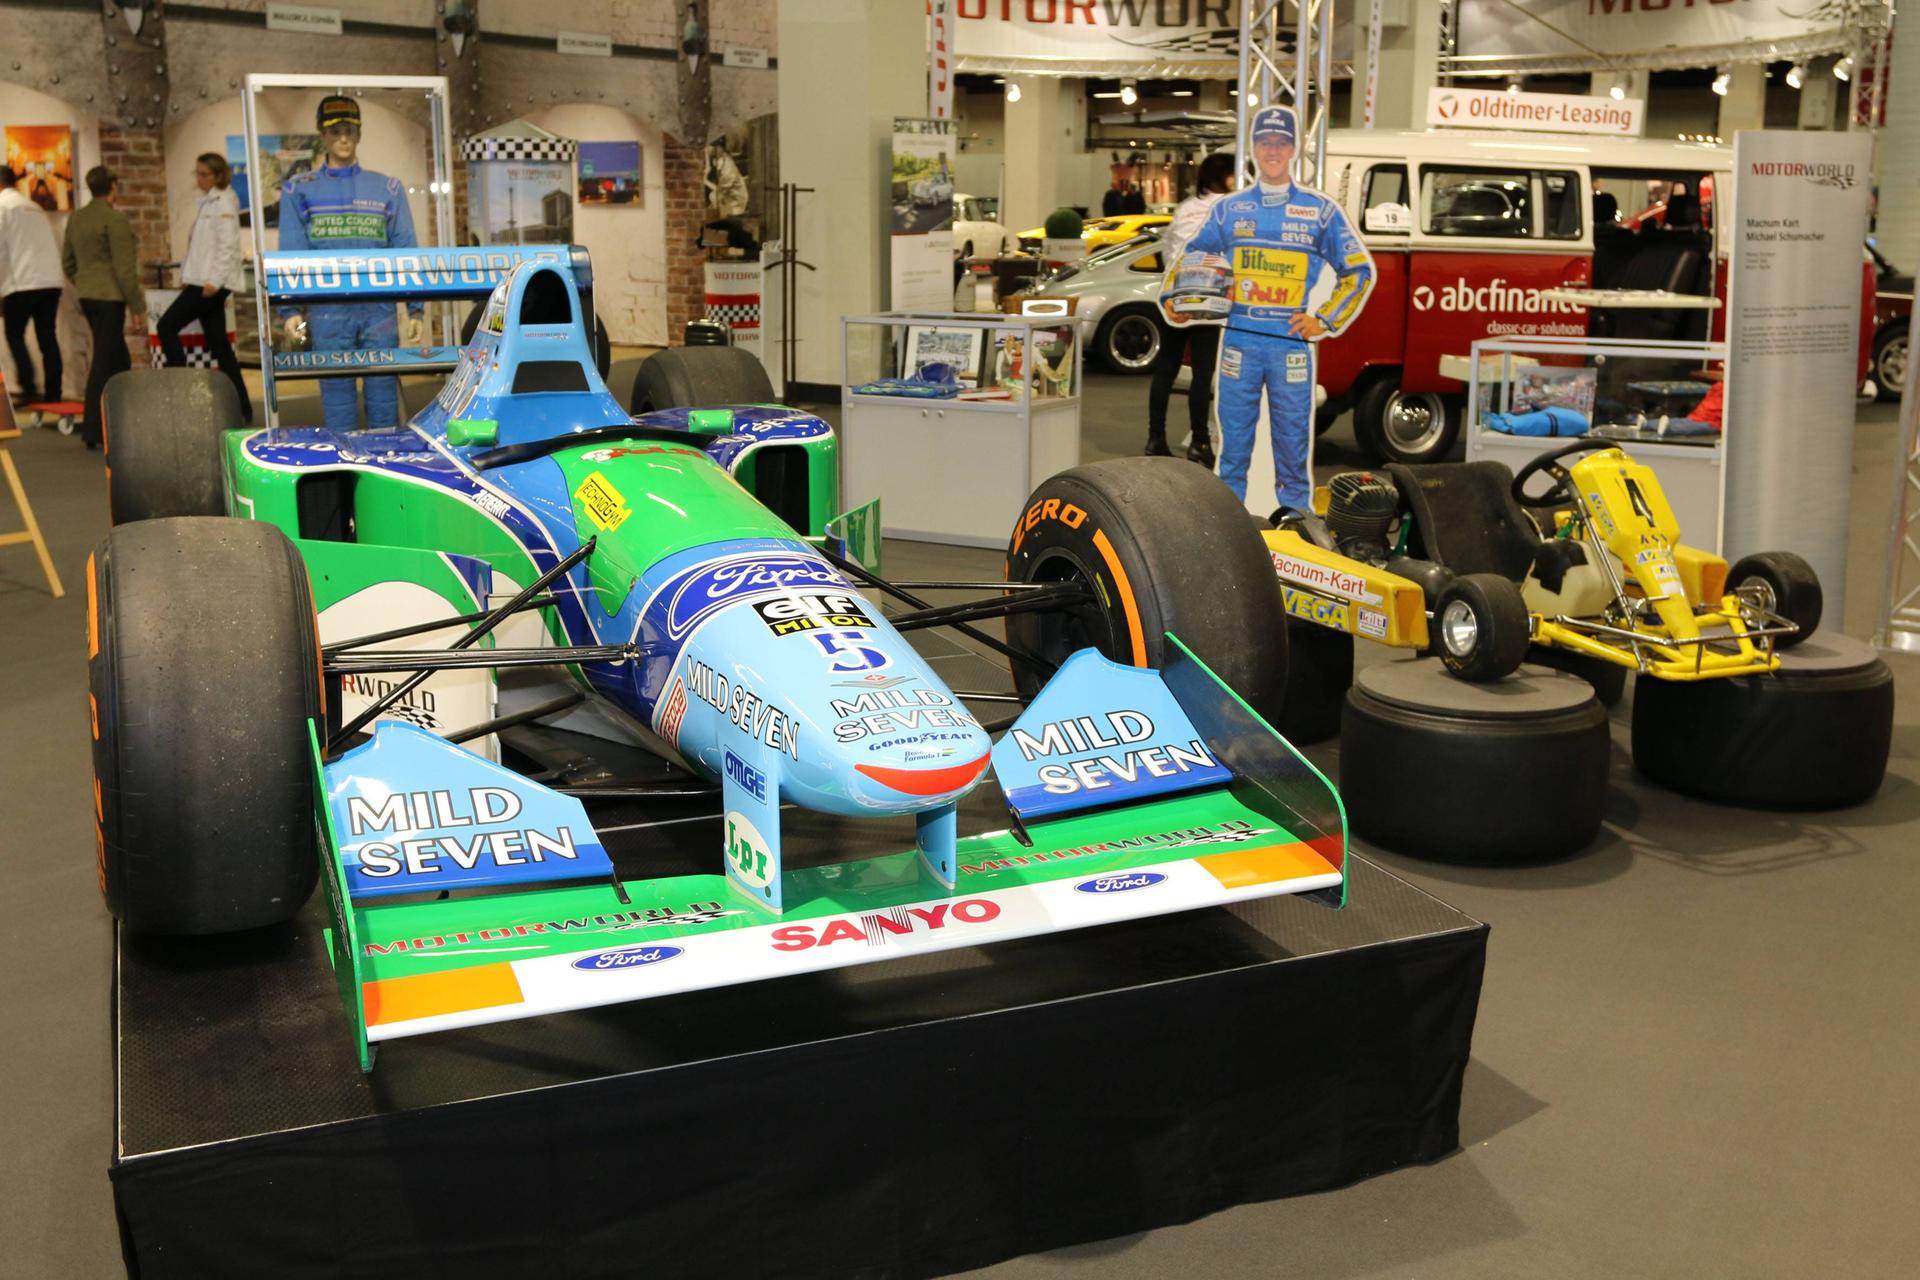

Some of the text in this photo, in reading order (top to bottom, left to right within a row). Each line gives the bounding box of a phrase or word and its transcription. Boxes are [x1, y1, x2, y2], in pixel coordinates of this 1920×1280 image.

[1469, 97, 1633, 131] Oldtimer-Leasing
[1751, 162, 1855, 178] MOTORWORLD
[1281, 222, 1309, 233] MILD
[1288, 207, 1318, 218] SANYO
[1782, 218, 1800, 228] Kart
[1281, 233, 1314, 245] SEVEN
[1746, 232, 1825, 242] Michael Schumacher
[1241, 248, 1296, 277] Bitburger
[274, 350, 395, 368] MILD SEVEN
[1012, 498, 1088, 556] ZERO
[706, 560, 848, 599] Ford
[762, 595, 855, 620] elf
[1280, 587, 1348, 632] VEGA
[808, 629, 892, 673] 5
[687, 654, 730, 715] MILD
[730, 684, 801, 762] SEVEN
[830, 689, 953, 719] MILD
[833, 709, 985, 743] SEVEN
[1010, 709, 1155, 761] MILD
[1038, 740, 1217, 795] SEVEN
[346, 787, 523, 837] MILD
[357, 825, 580, 879] SEVEN
[959, 819, 1253, 875] MOTORWORLD
[1095, 875, 1150, 891] Ford
[363, 901, 724, 957] MOTORWORLD
[770, 899, 1001, 952] SANYO
[597, 947, 664, 967] Ford
